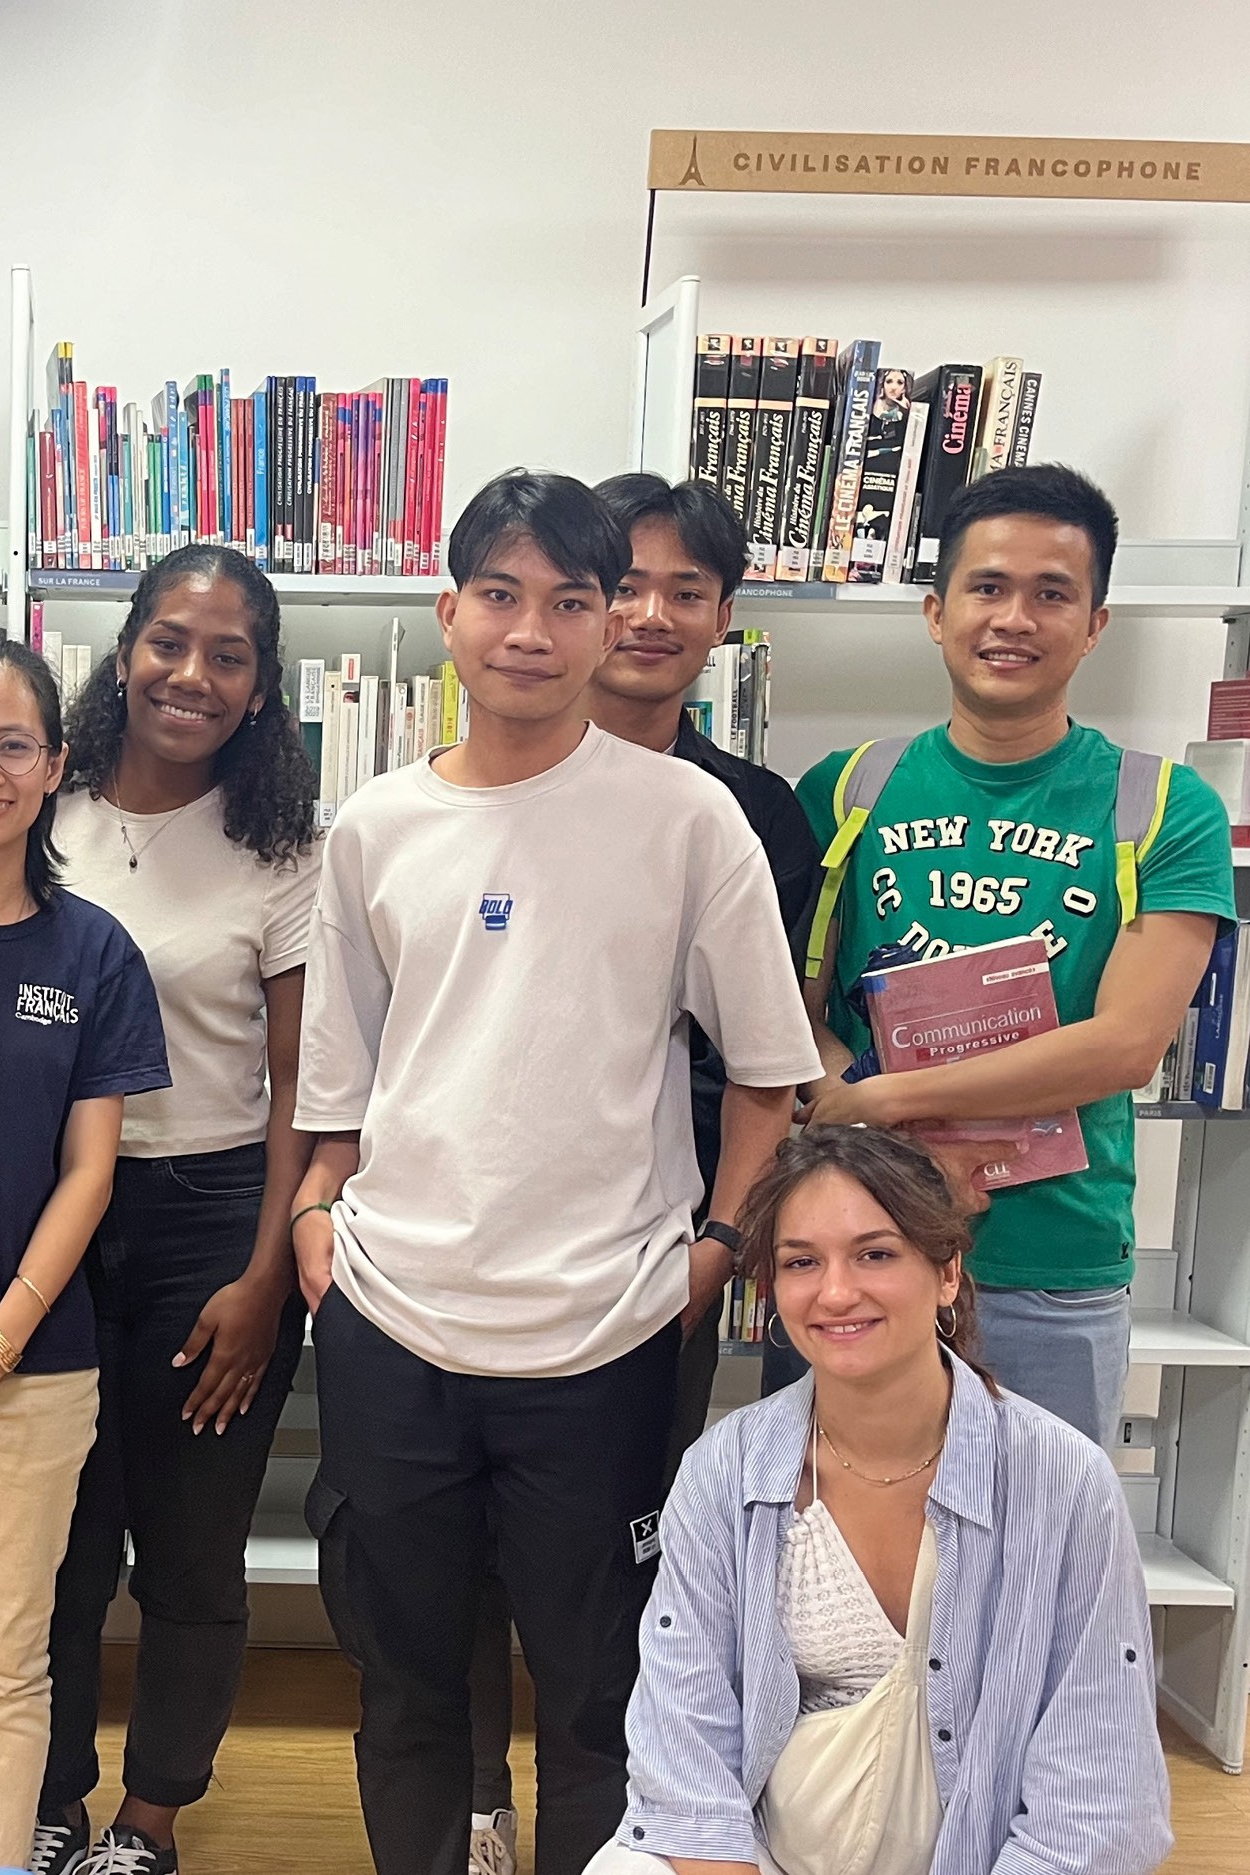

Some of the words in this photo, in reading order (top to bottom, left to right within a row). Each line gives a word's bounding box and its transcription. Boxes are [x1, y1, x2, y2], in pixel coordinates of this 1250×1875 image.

[733, 152, 950, 176] CIVILISATION
[965, 157, 1203, 182] FRANCOPHONE
[297, 409, 303, 418] DU
[307, 408, 314, 418] DU
[993, 360, 1018, 448] FRANÇAIS
[1019, 378, 1038, 426] CANNES
[287, 417, 293, 426] DU
[844, 389, 870, 455] FRANÇAIS
[941, 381, 974, 456] Cinéma
[256, 448, 266, 476] France
[698, 411, 722, 485] Français
[727, 410, 752, 485] Français
[758, 413, 785, 487] Français
[796, 410, 823, 485] Français
[756, 485, 764, 498] du
[793, 482, 801, 494] du
[837, 451, 860, 514] CINÉMA
[863, 475, 895, 487] CINÉMA
[752, 486, 777, 546] Cinéma
[753, 498, 763, 529] Histoire
[788, 484, 815, 549] Cinéma
[789, 494, 799, 526] Histoire
[834, 513, 851, 532] LE
[38, 577, 54, 585] SUR
[55, 578, 67, 586] LA
[68, 578, 101, 587] FRANCE
[730, 732, 737, 740] LE
[877, 815, 969, 856] NEW
[987, 819, 1095, 868] YORK
[927, 869, 1030, 916] 1965
[16, 996, 79, 1024] FRANÇAIS
[18, 983, 75, 1011] INSTITUT
[891, 1004, 1042, 1049] Communication
[929, 1030, 1021, 1057] Progressive
